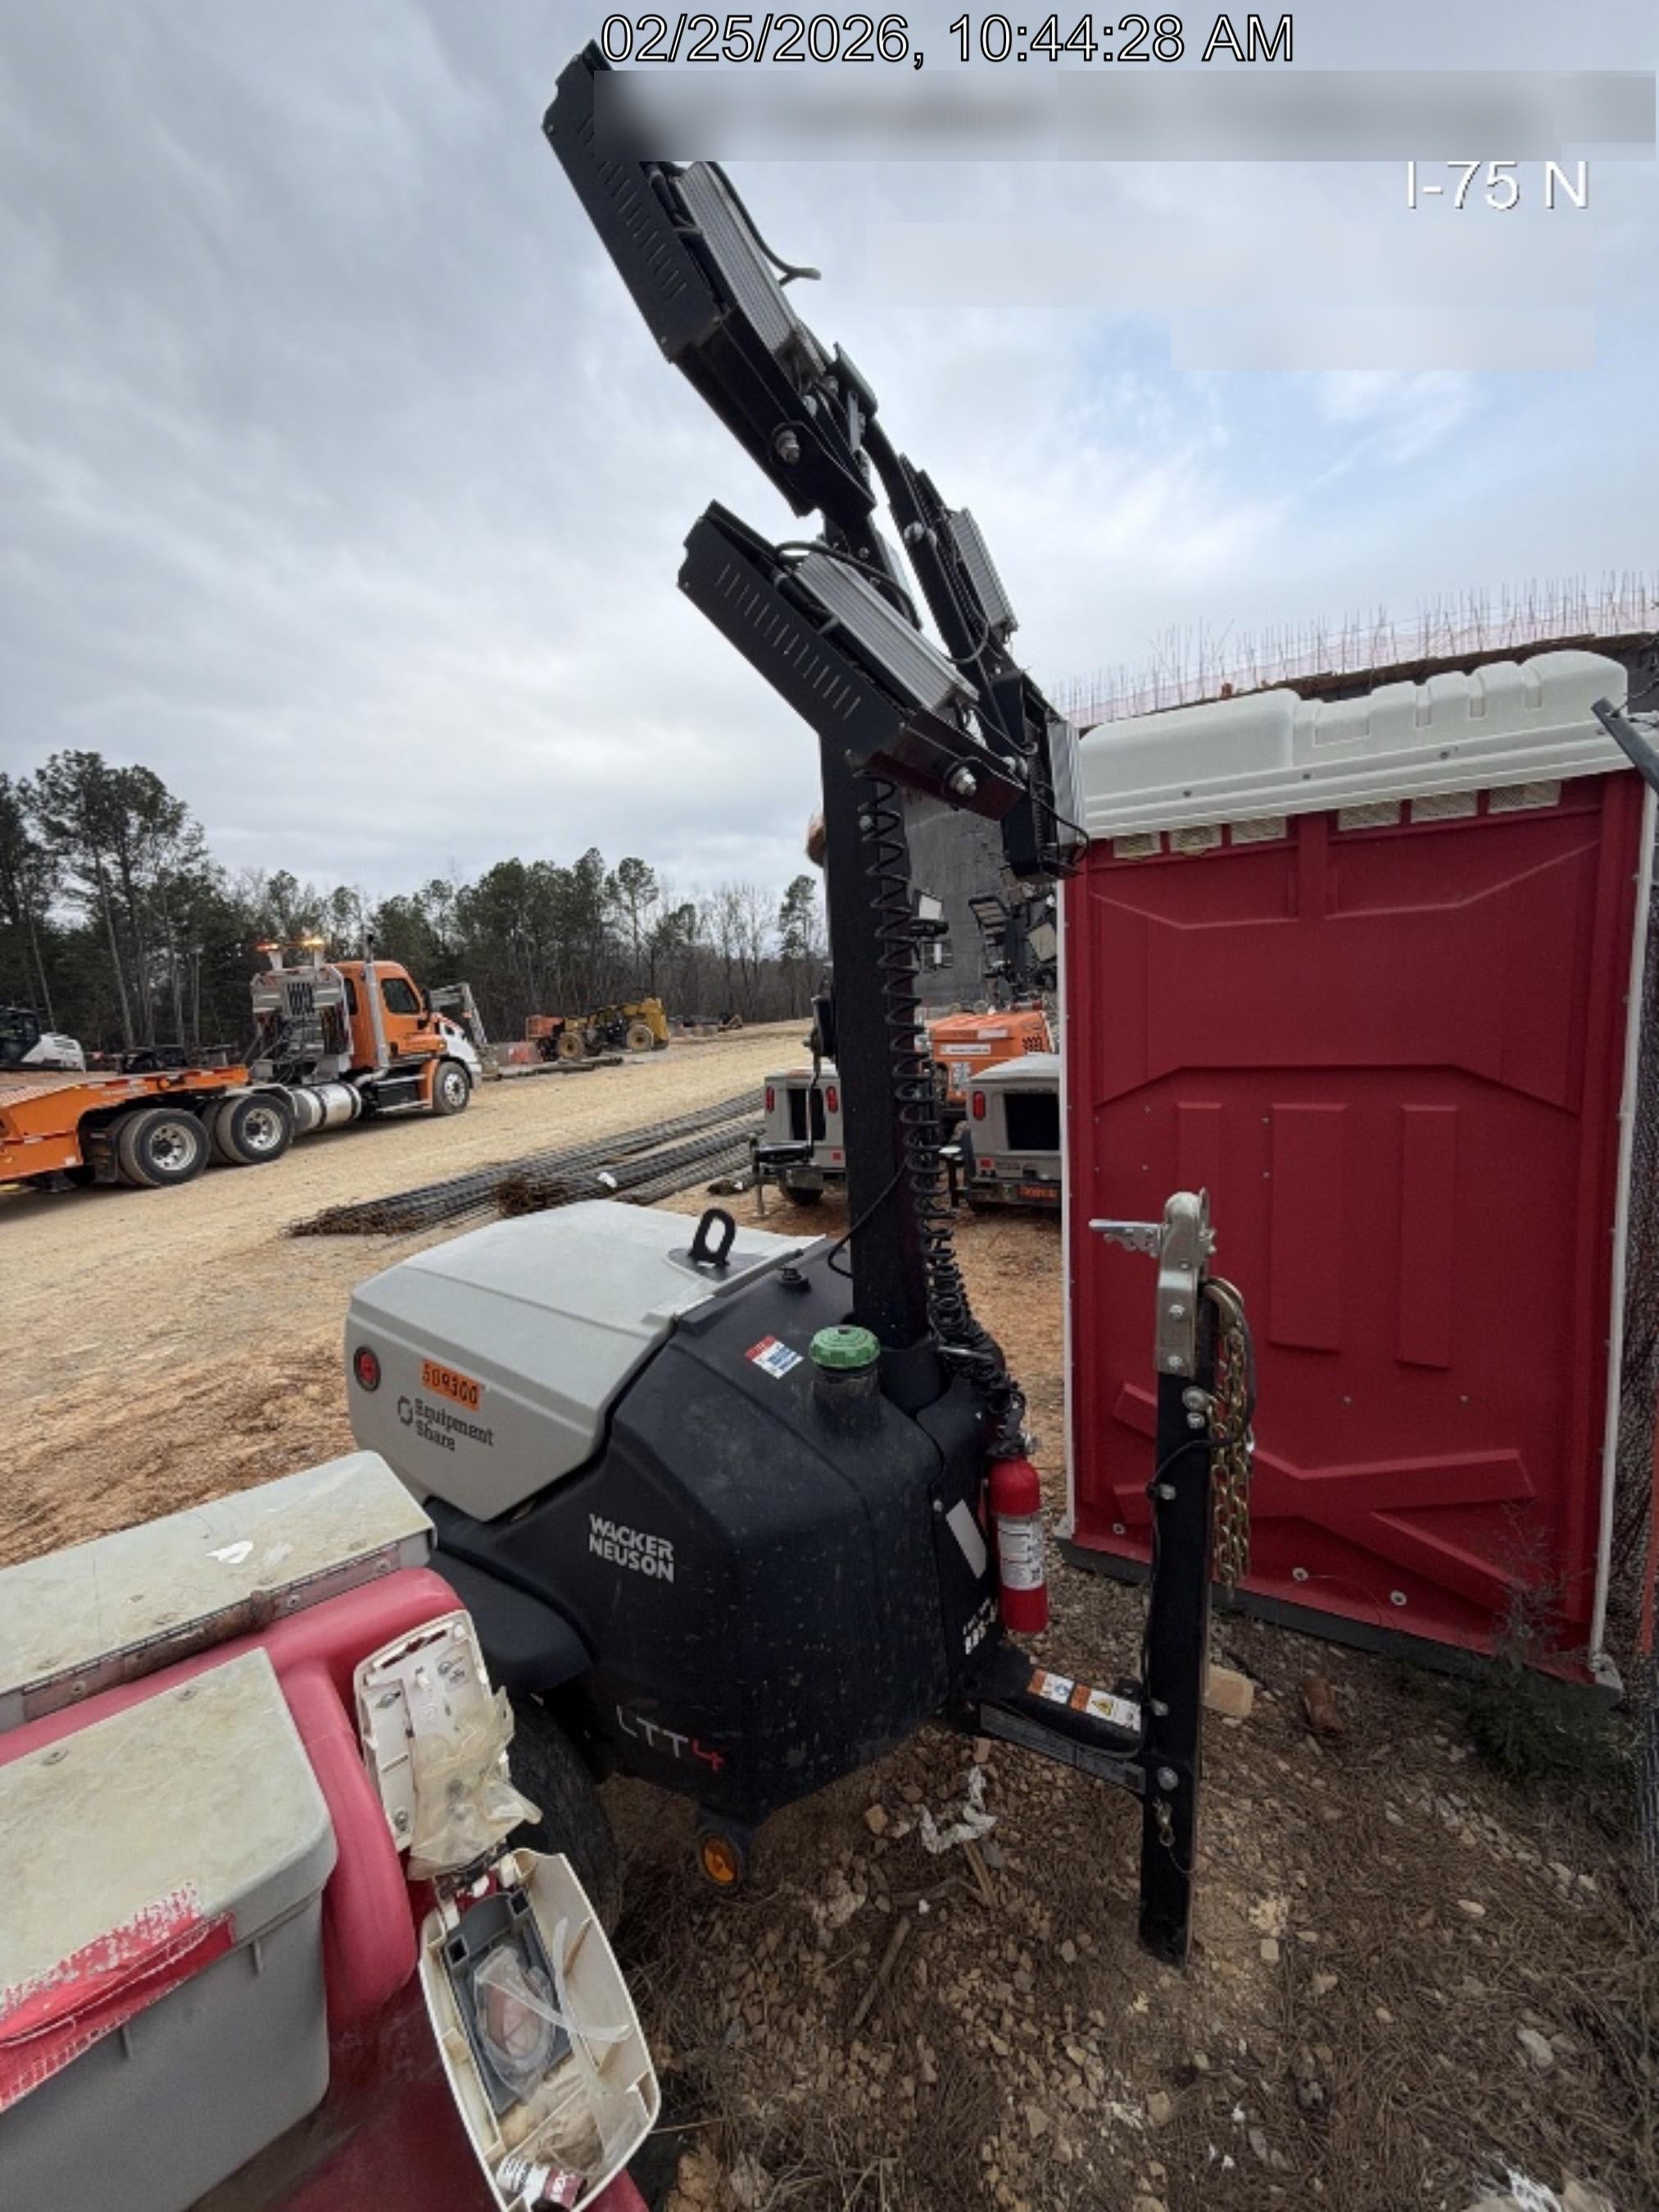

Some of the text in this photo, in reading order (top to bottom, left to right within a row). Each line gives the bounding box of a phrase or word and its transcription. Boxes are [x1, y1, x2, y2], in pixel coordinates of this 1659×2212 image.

[415, 1398, 494, 1447] Equipment
[589, 1513, 674, 1562] WACKER
[589, 1533, 674, 1584] NEUSON
[616, 1705, 724, 1772] LTT4
